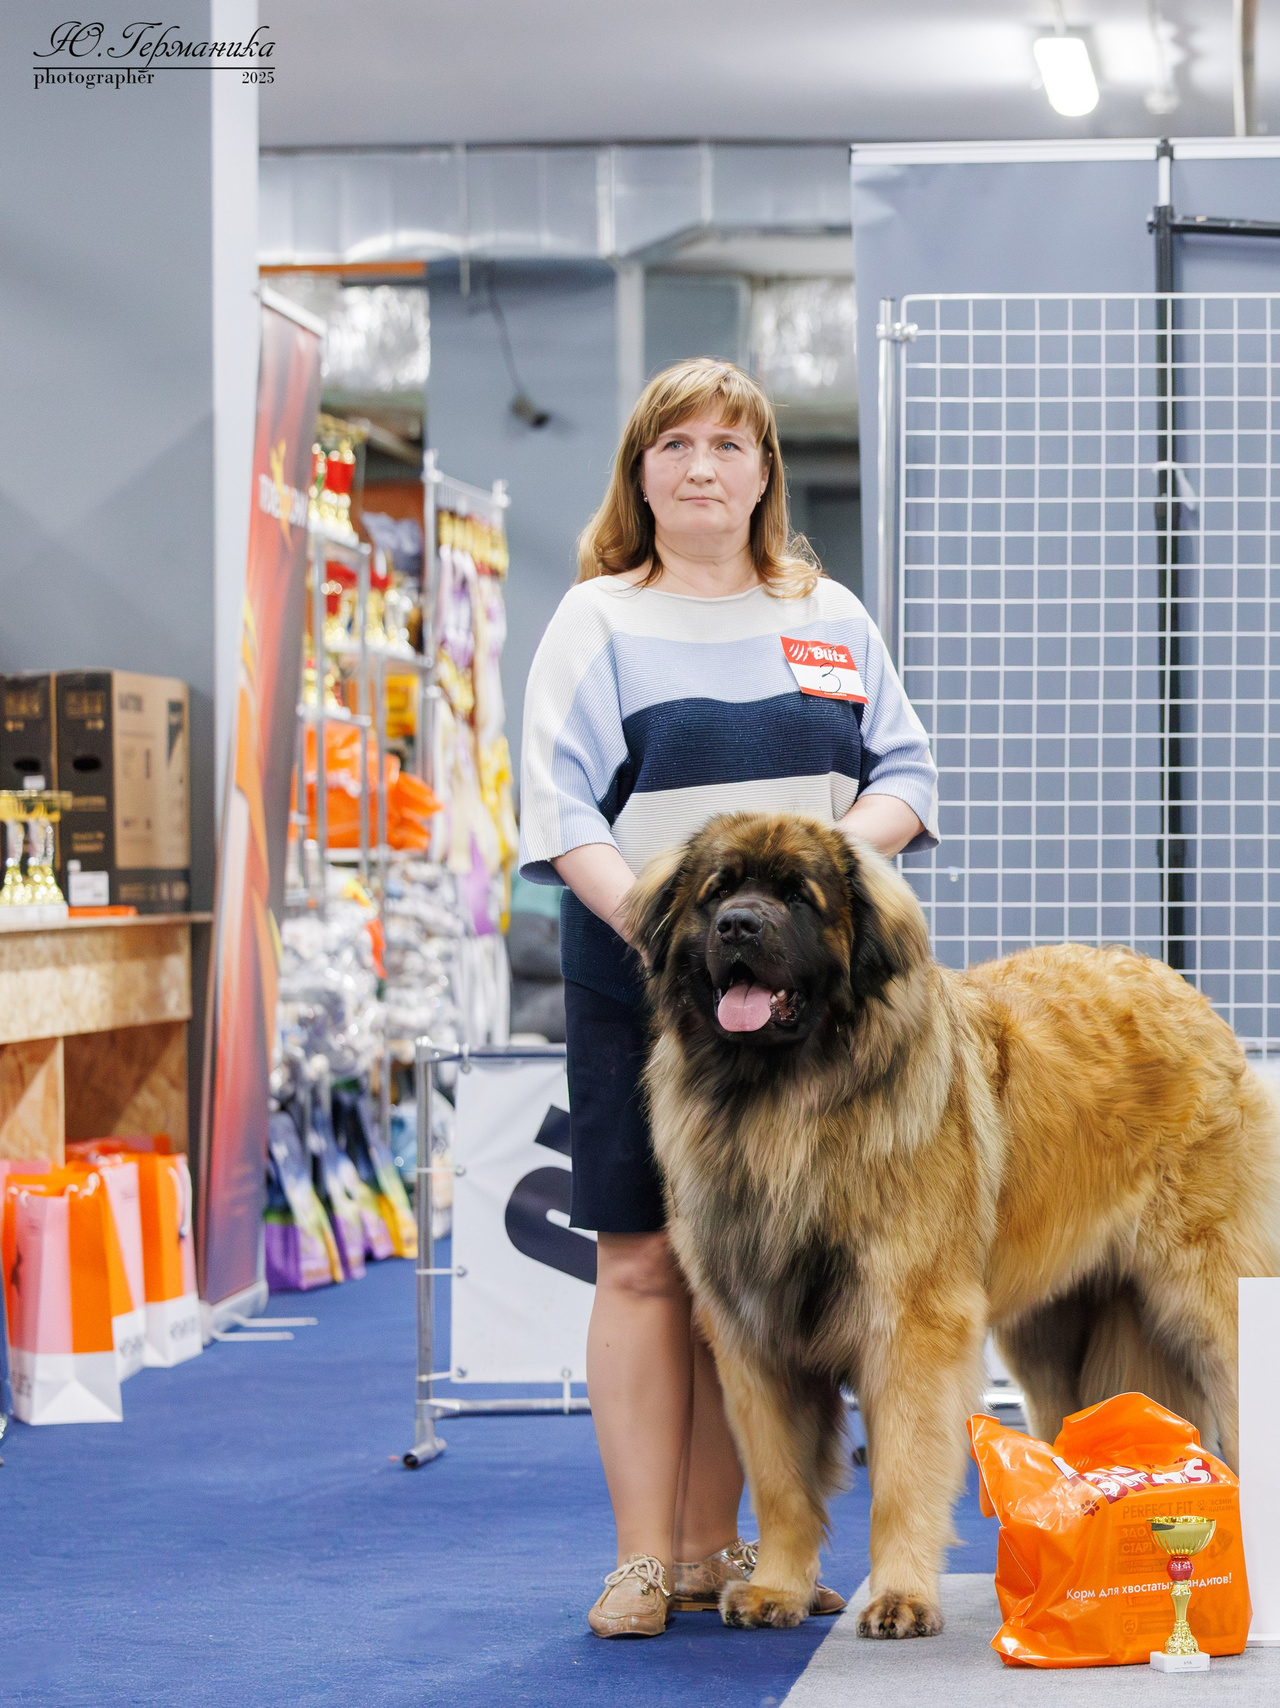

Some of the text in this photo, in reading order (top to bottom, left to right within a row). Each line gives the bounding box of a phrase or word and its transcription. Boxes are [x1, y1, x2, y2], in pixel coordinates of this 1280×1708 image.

[811, 647, 848, 663] Blitz
[819, 662, 842, 693] 3
[1122, 1502, 1173, 1519] PERFECT
[1176, 1500, 1194, 1515] FIT
[1066, 1588, 1096, 1601] Корм
[1099, 1586, 1119, 1598] для
[1187, 1572, 1232, 1588] андитов!
